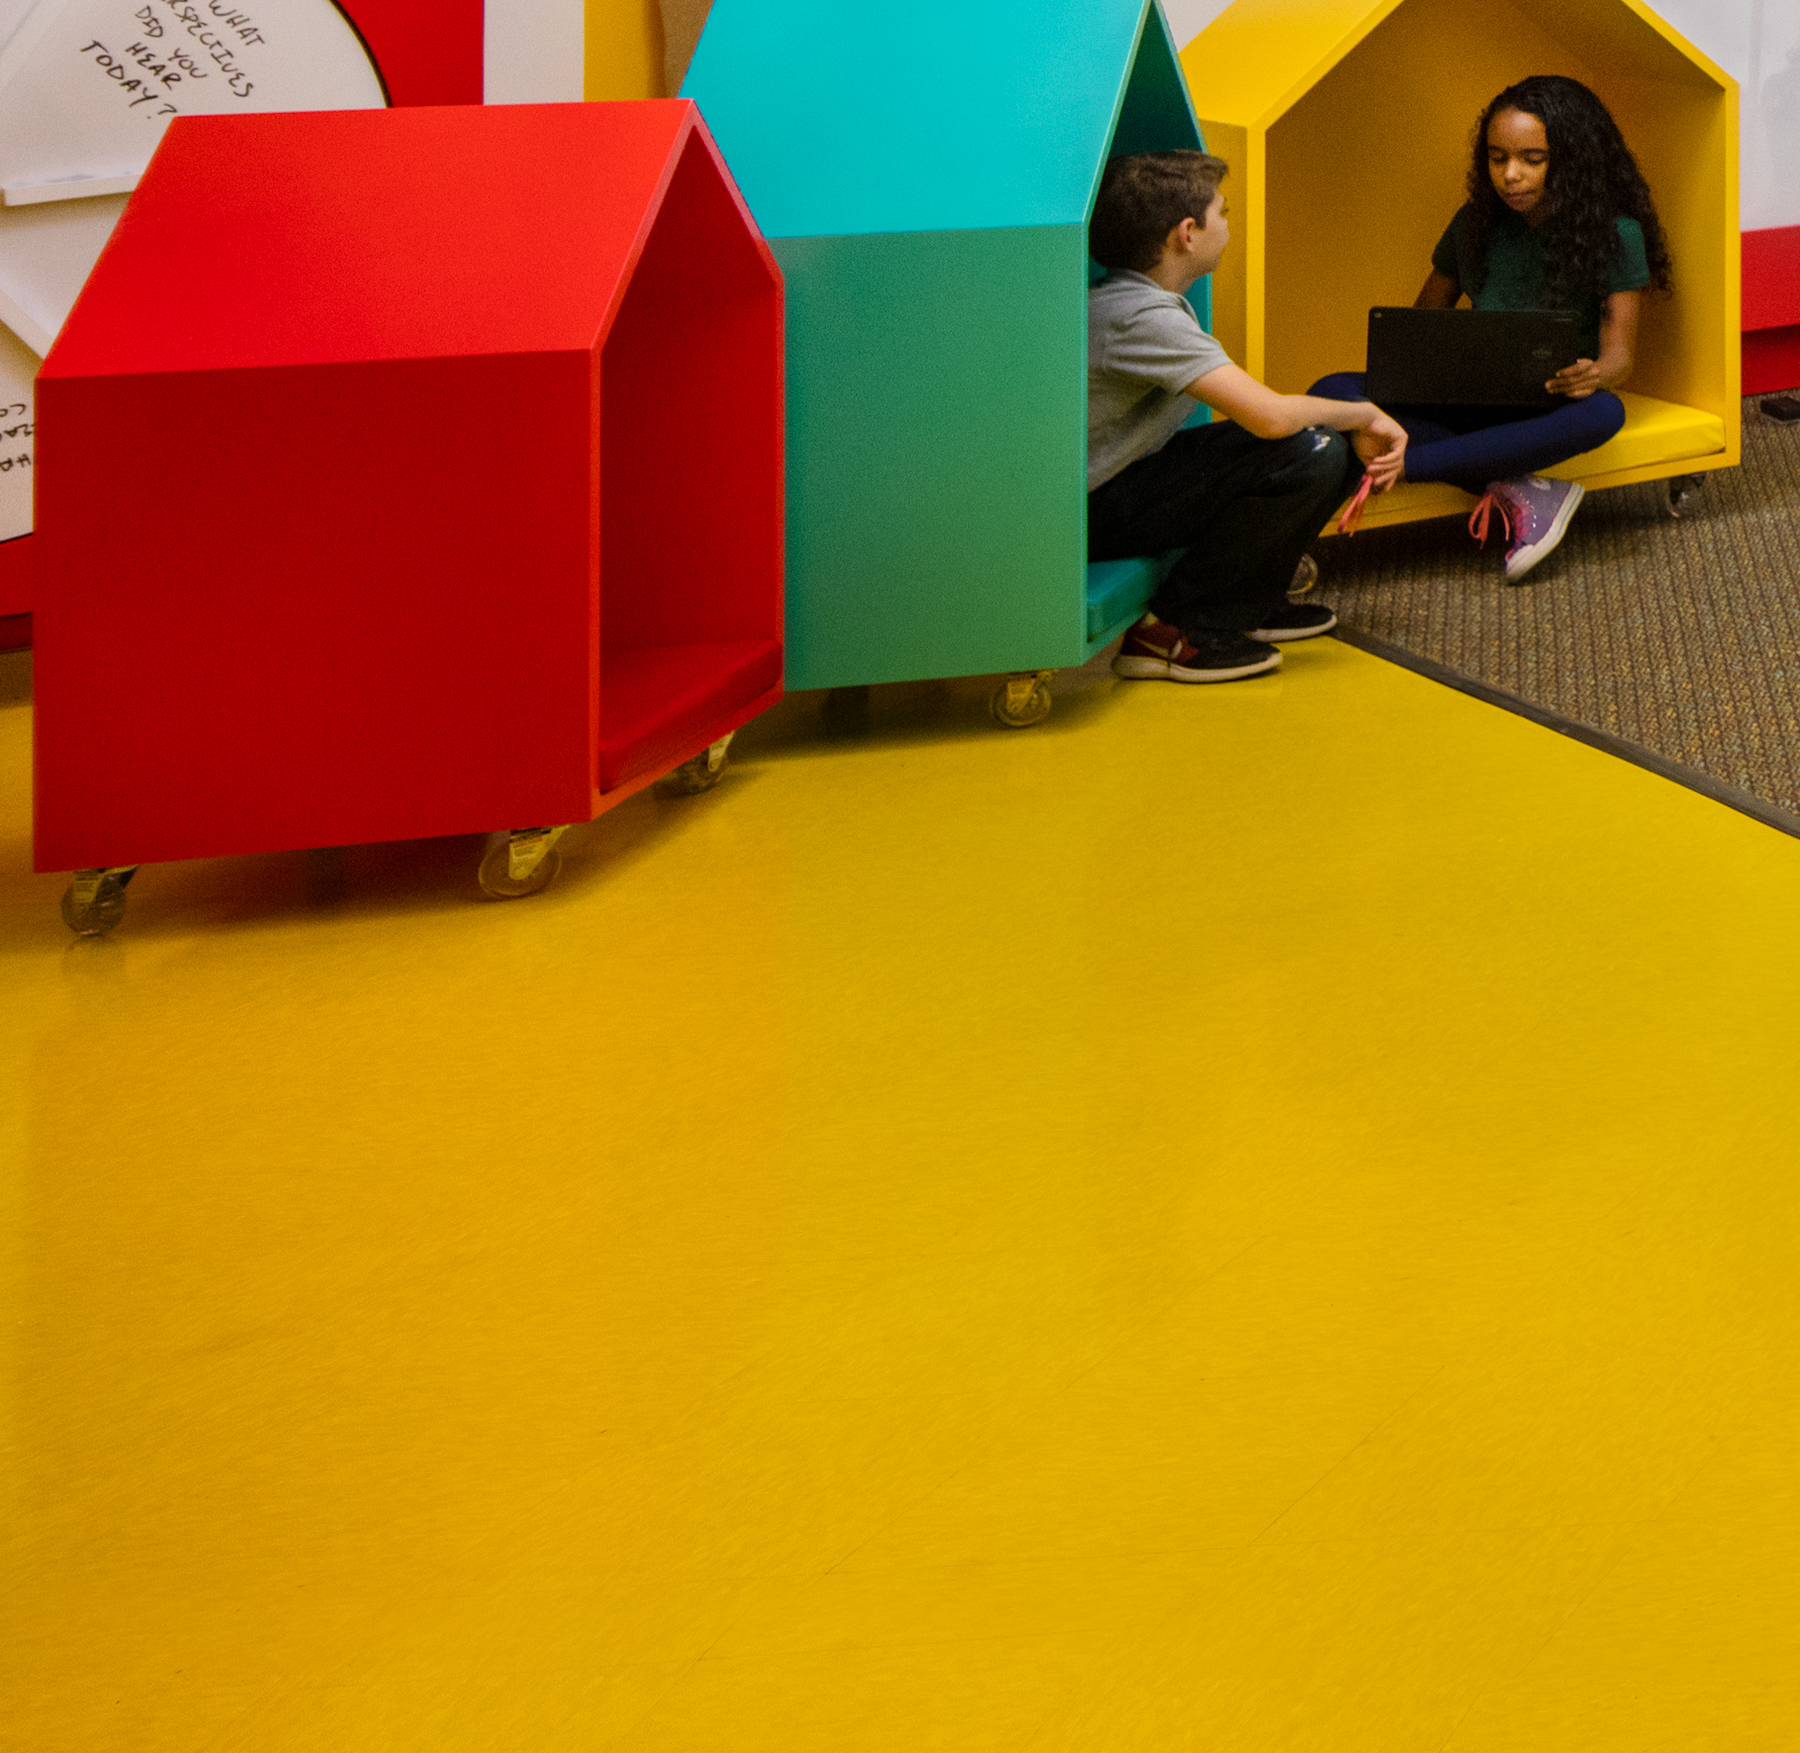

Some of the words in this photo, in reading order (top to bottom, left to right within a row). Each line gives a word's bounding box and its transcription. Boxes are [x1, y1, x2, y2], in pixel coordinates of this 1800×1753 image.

[125, 42, 182, 91] HEAR
[135, 5, 164, 38] DID
[168, 48, 208, 79] YOU
